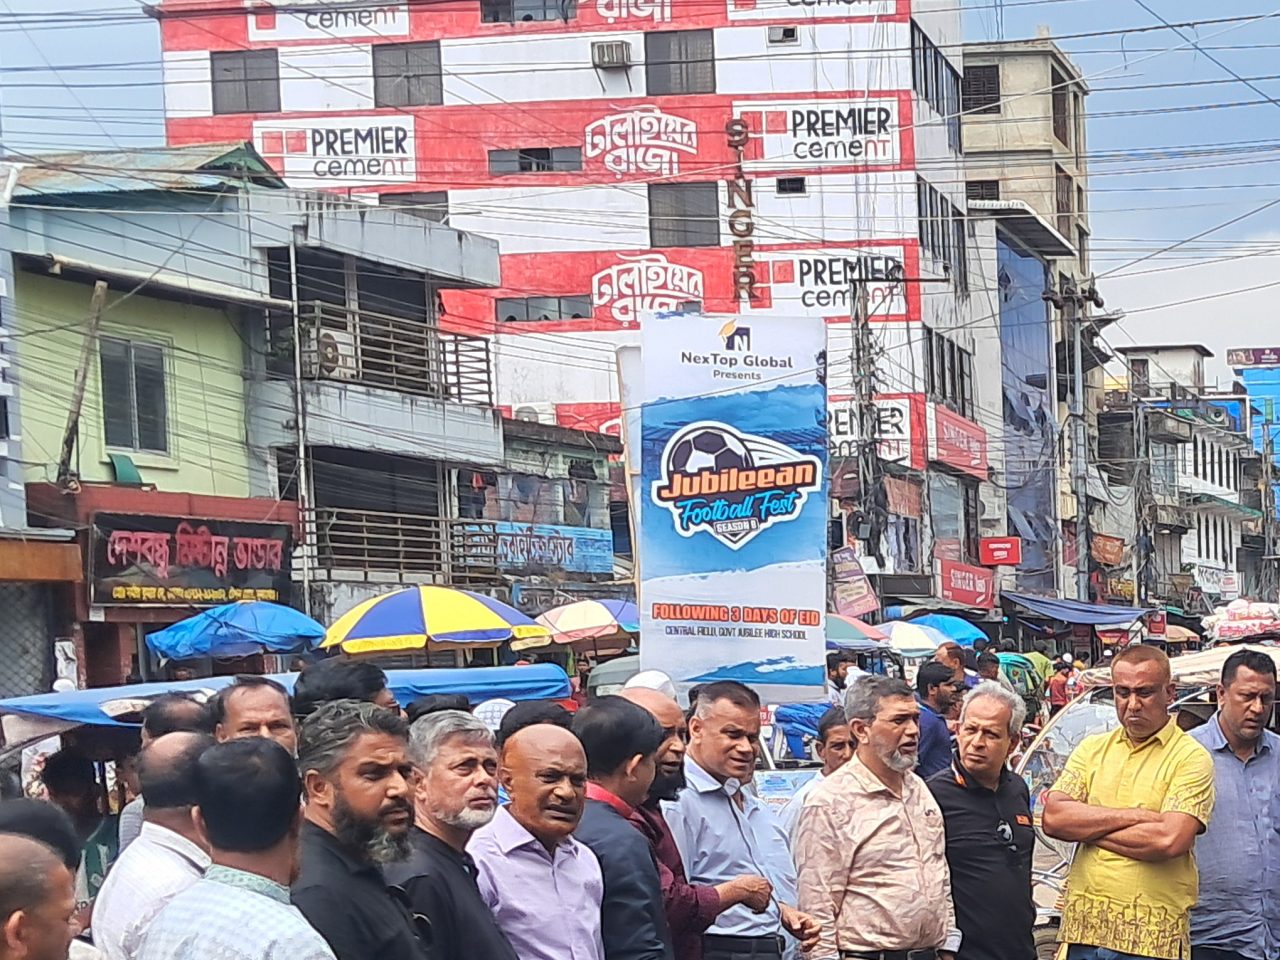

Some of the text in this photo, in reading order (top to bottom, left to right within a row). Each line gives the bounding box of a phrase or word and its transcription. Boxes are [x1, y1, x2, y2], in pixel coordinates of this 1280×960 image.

[791, 106, 891, 138] PREMIER
[311, 126, 408, 156] PREMIER
[725, 119, 759, 301] SINGER
[681, 352, 793, 368] NexTop Global
[713, 370, 762, 380] Presents
[660, 463, 814, 499] Jubileean
[676, 489, 799, 530] Football Fest
[715, 522, 749, 533] SEASON
[107, 530, 171, 580] দেশবন্ধু
[652, 603, 820, 626] FOLLOWING 3 DAYS OF EID
[665, 626, 696, 636] CENTRAL
[764, 629, 781, 639] HIGH
[781, 630, 807, 640] SCHOOL
